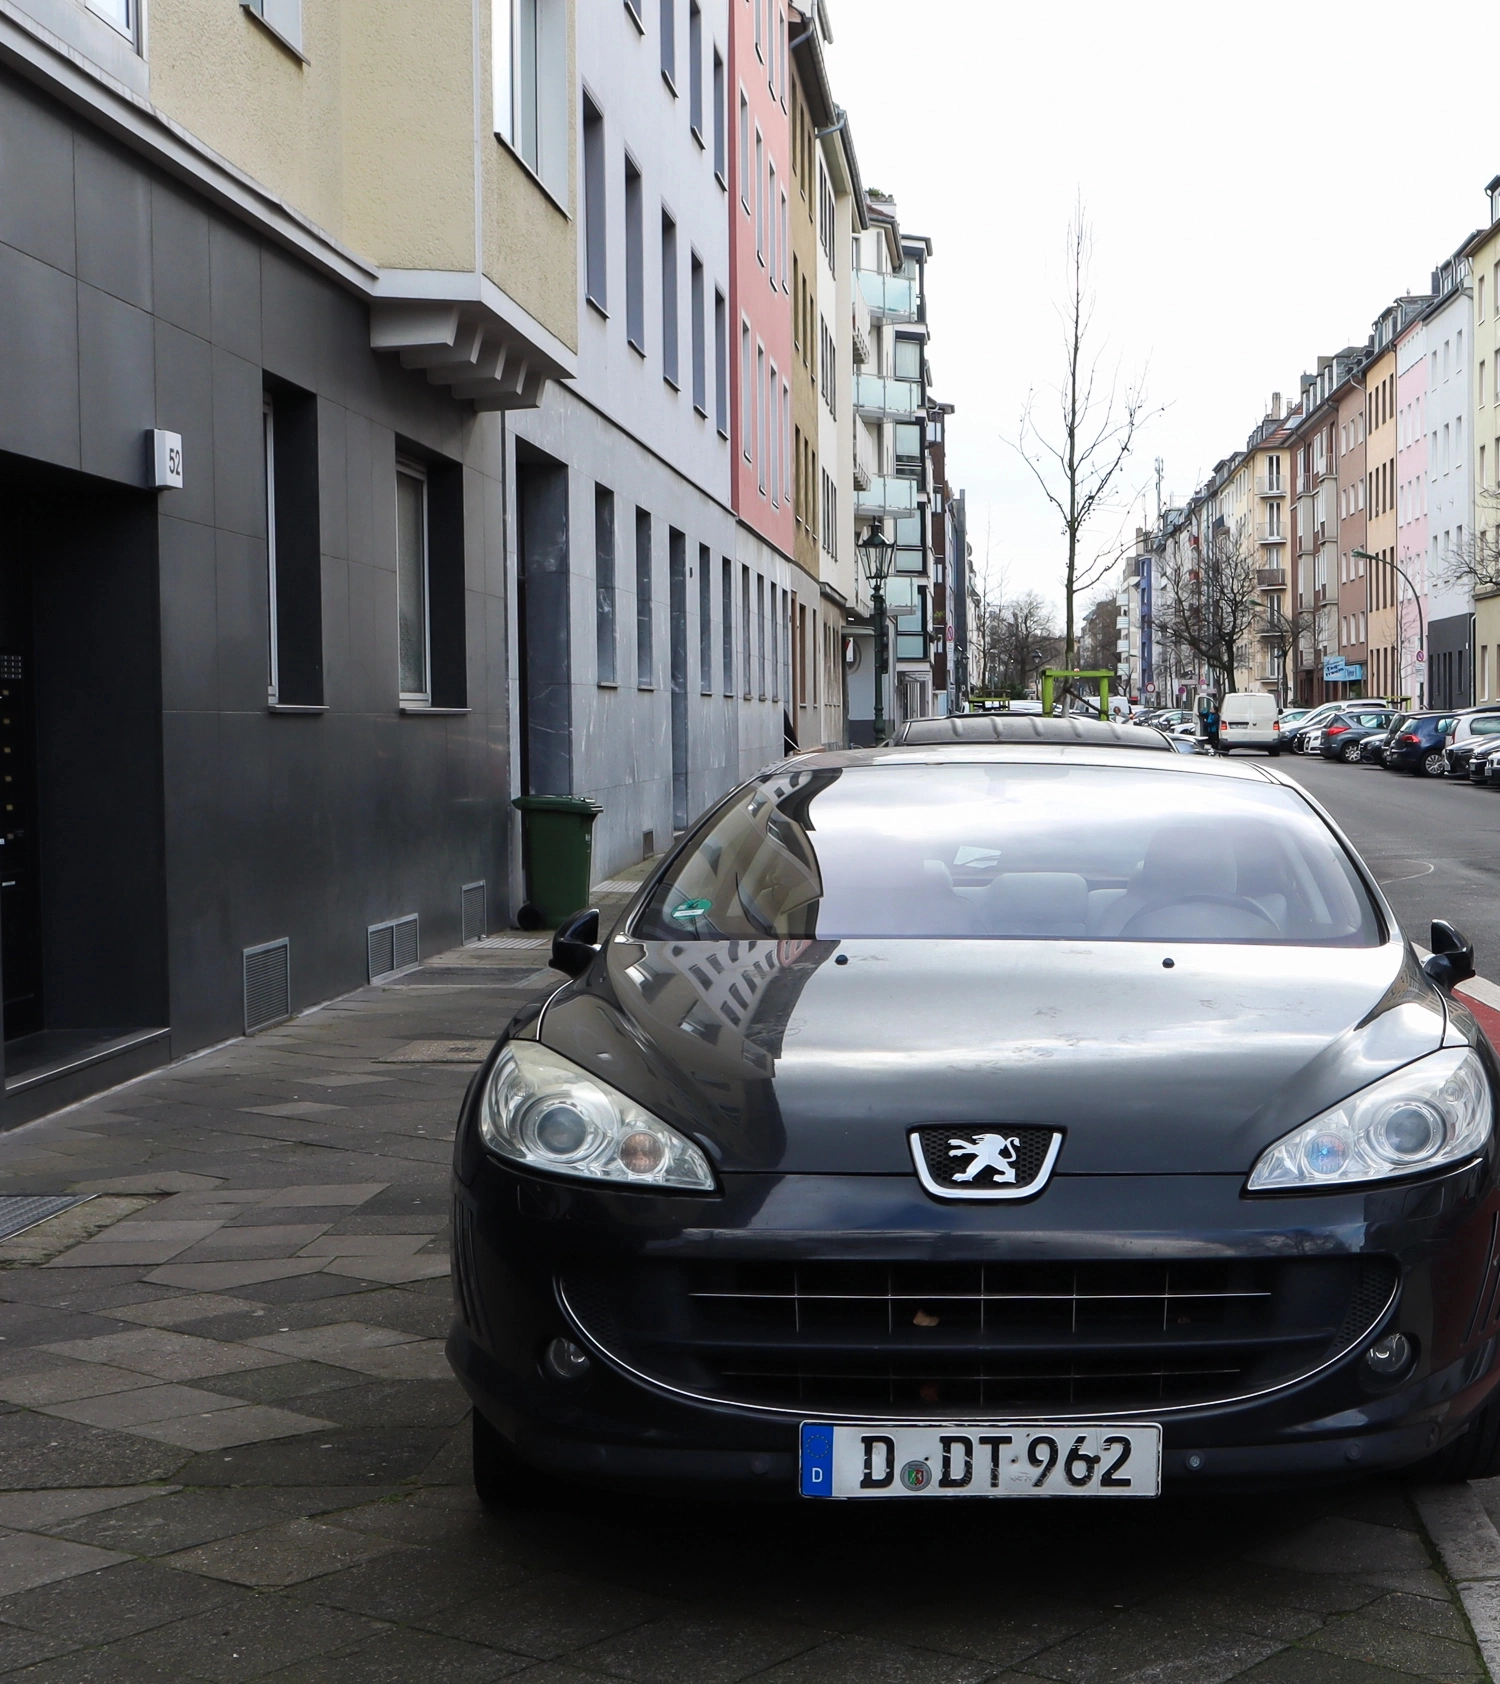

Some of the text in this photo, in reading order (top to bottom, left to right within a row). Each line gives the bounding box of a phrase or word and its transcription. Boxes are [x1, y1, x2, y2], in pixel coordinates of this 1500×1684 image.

[169, 447, 181, 476] 52
[812, 1467, 823, 1483] D
[860, 1435, 1132, 1490] D DT 962
